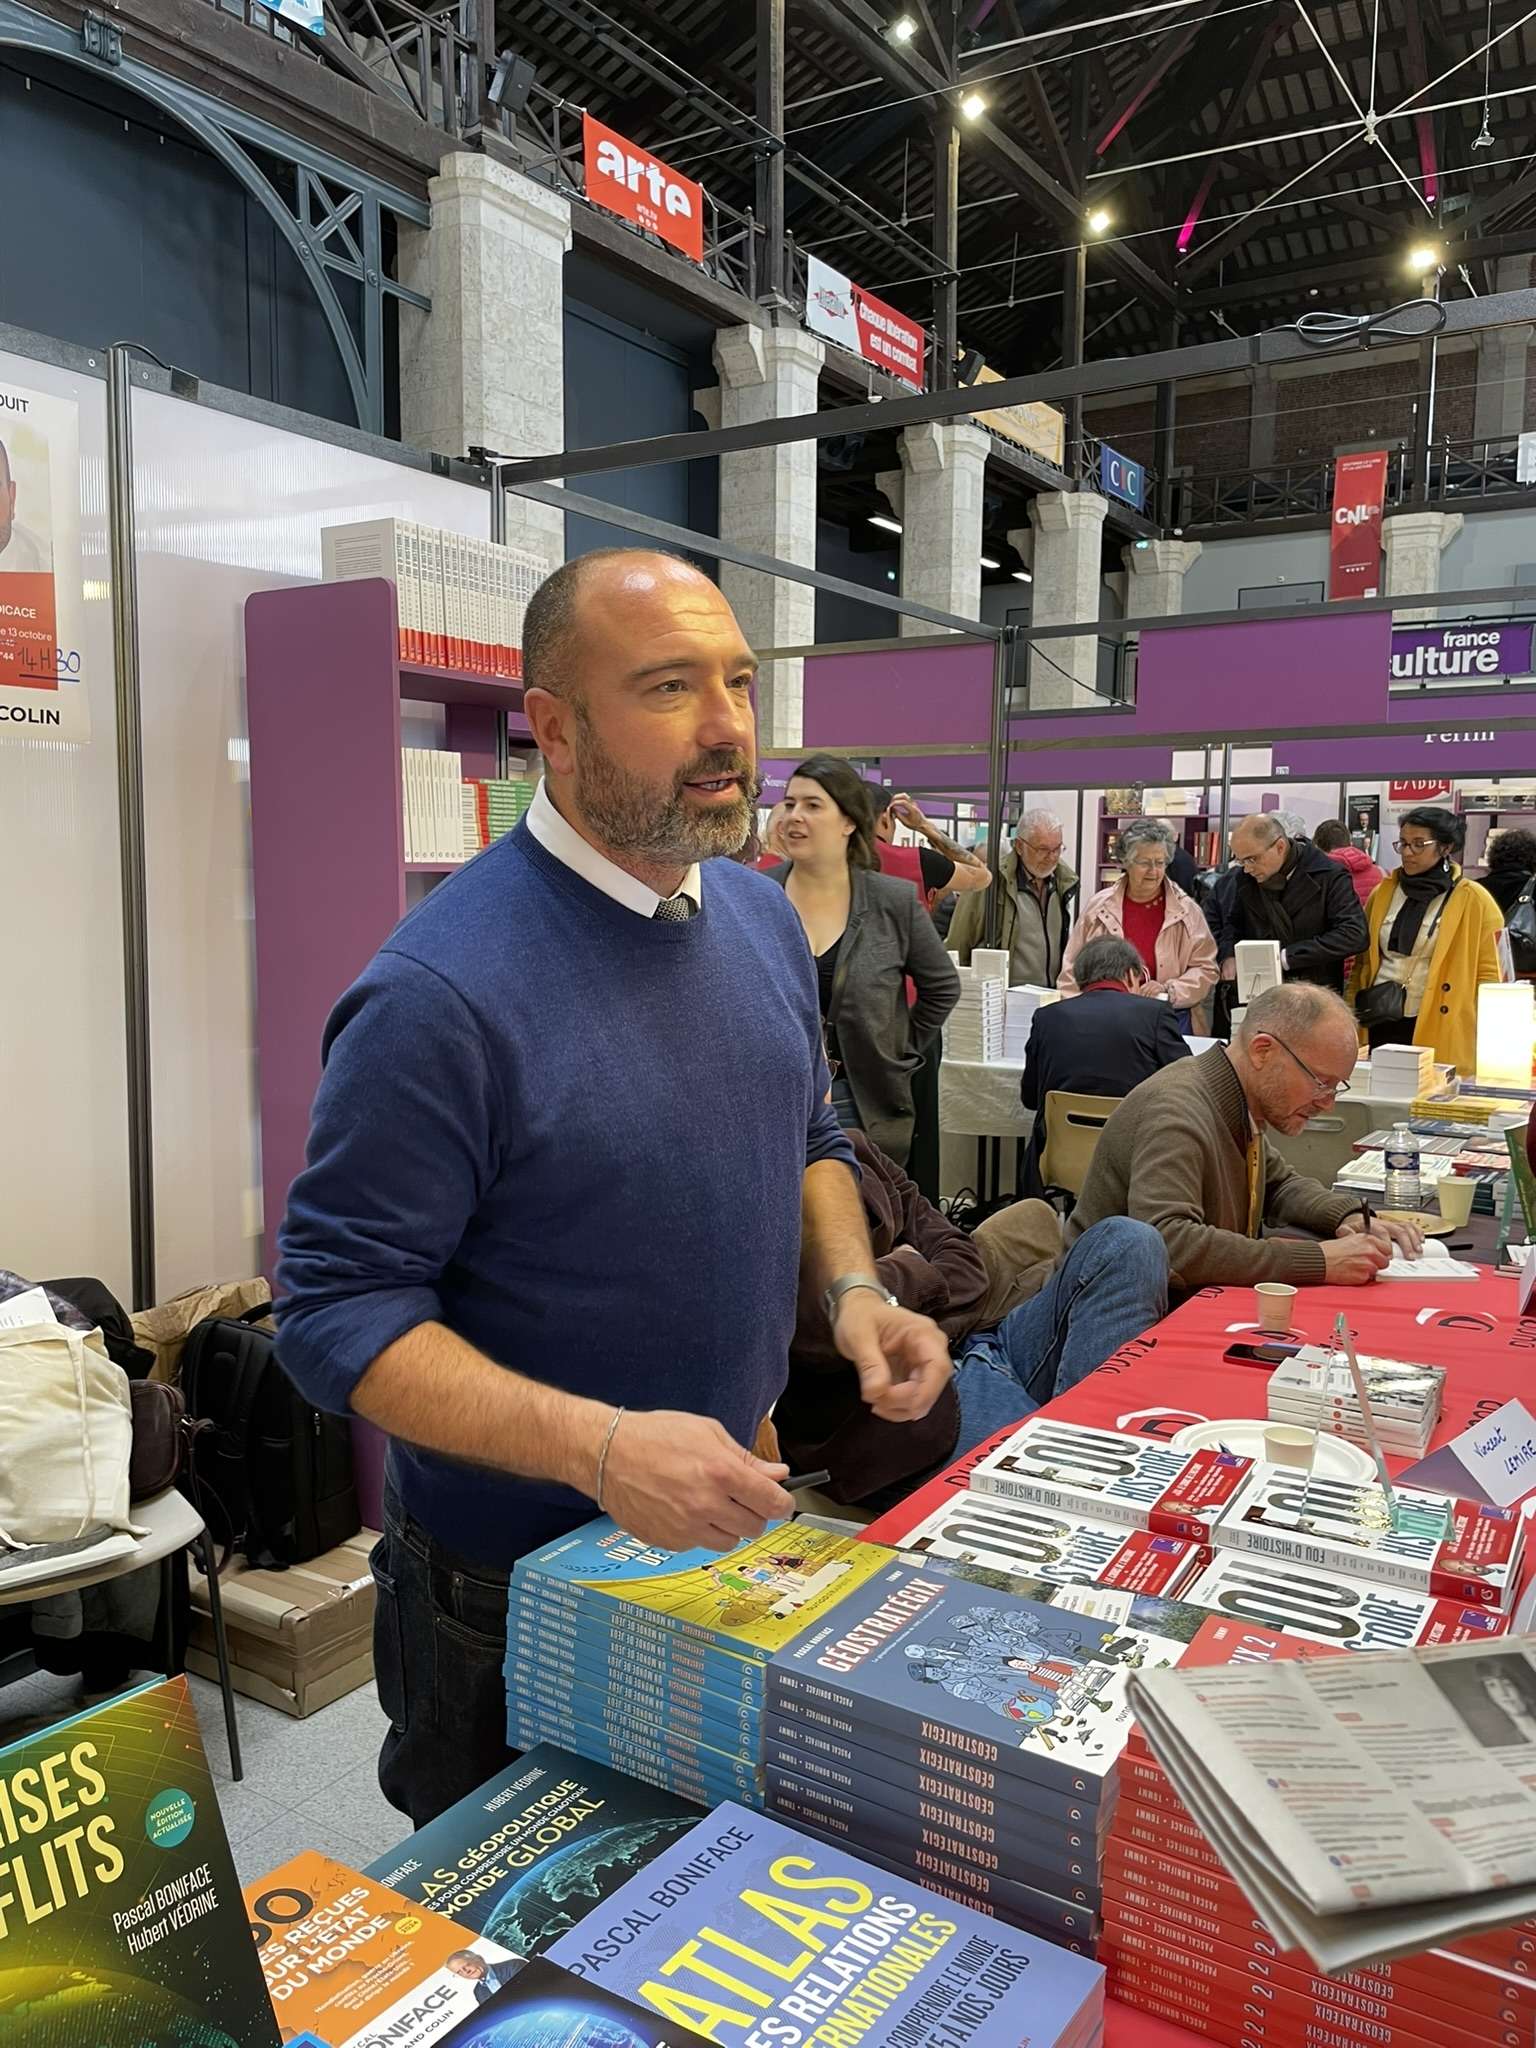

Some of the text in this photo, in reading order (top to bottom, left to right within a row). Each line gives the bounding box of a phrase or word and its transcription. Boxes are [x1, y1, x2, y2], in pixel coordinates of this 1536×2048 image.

[597, 140, 692, 219] arte
[19, 630, 53, 642] octobre
[1443, 631, 1500, 648] france
[1389, 646, 1499, 678] ulture
[0, 705, 60, 726] COLIN
[1106, 1446, 1191, 1503] HISTOIRE
[1044, 1490, 1061, 1506] FOU
[1033, 1526, 1127, 1586] ISTOIRE
[1305, 1546, 1325, 1564] FOU
[816, 1577, 946, 1673] GÉOSTRATÉGIX
[1343, 1593, 1425, 1651] STOIRE
[921, 1721, 998, 1761] GÉOSTRATÉGIX
[483, 1767, 548, 1813] HUBERT VÉDRINE
[920, 1748, 995, 1789] GÉOSTRATÉGIX
[150, 1798, 186, 1821] NOUVELLE
[919, 1775, 994, 1816] GÉOSTRATÉGIX
[152, 1813, 193, 1840] ACTUALISÉE
[156, 1808, 185, 1828] ÉDITION
[920, 1802, 995, 1843] GÉOSTRATÉGIX
[421, 1779, 579, 1905] AS GÉOPOLITIQUE
[427, 1785, 589, 1911] ES POUR COMPRENDRE UN MONDE CHAOTIQUE
[441, 1797, 605, 1920] MONDE GLOBAL
[922, 1829, 998, 1869] GÉOSTRATÉGIX
[380, 1859, 424, 1888] ONIFACE
[915, 1850, 990, 1893] GÉOSTRATÉGIX
[112, 1863, 213, 1934] Pascal BONIFACE
[567, 1826, 755, 1977] PASCAL BONIFACE
[1125, 1891, 1220, 1935] PASCAL BONIFACE TOMMY
[126, 1888, 219, 1956] Hubert VÉDRINE
[260, 1887, 370, 1966] ES REÇUES
[299, 1908, 372, 1955] L'ÉTAT
[1119, 1910, 1214, 1953] PASCAL BONIFACE TOMMY
[271, 1973, 309, 2001] DU
[312, 1914, 392, 1975] MONDE
[638, 1856, 874, 2046] ATLAS
[743, 1896, 918, 2048] ES RELATIONS
[1122, 1933, 1217, 1977] PASCAL BONIFACE TOMMY
[1248, 1960, 1270, 1976] 2
[800, 1912, 957, 2048] ERNATIONALES
[887, 1934, 999, 2048] COMPRENDRE LE MONDE
[977, 1949, 1031, 2000] JOURS
[1251, 1983, 1273, 1999] 2
[365, 1985, 459, 2048] ONIFACE
[404, 2010, 454, 2048] AND COLIN
[952, 1993, 996, 2029] NOS
[353, 2033, 377, 2048] CAL
[942, 2022, 972, 2045] À
